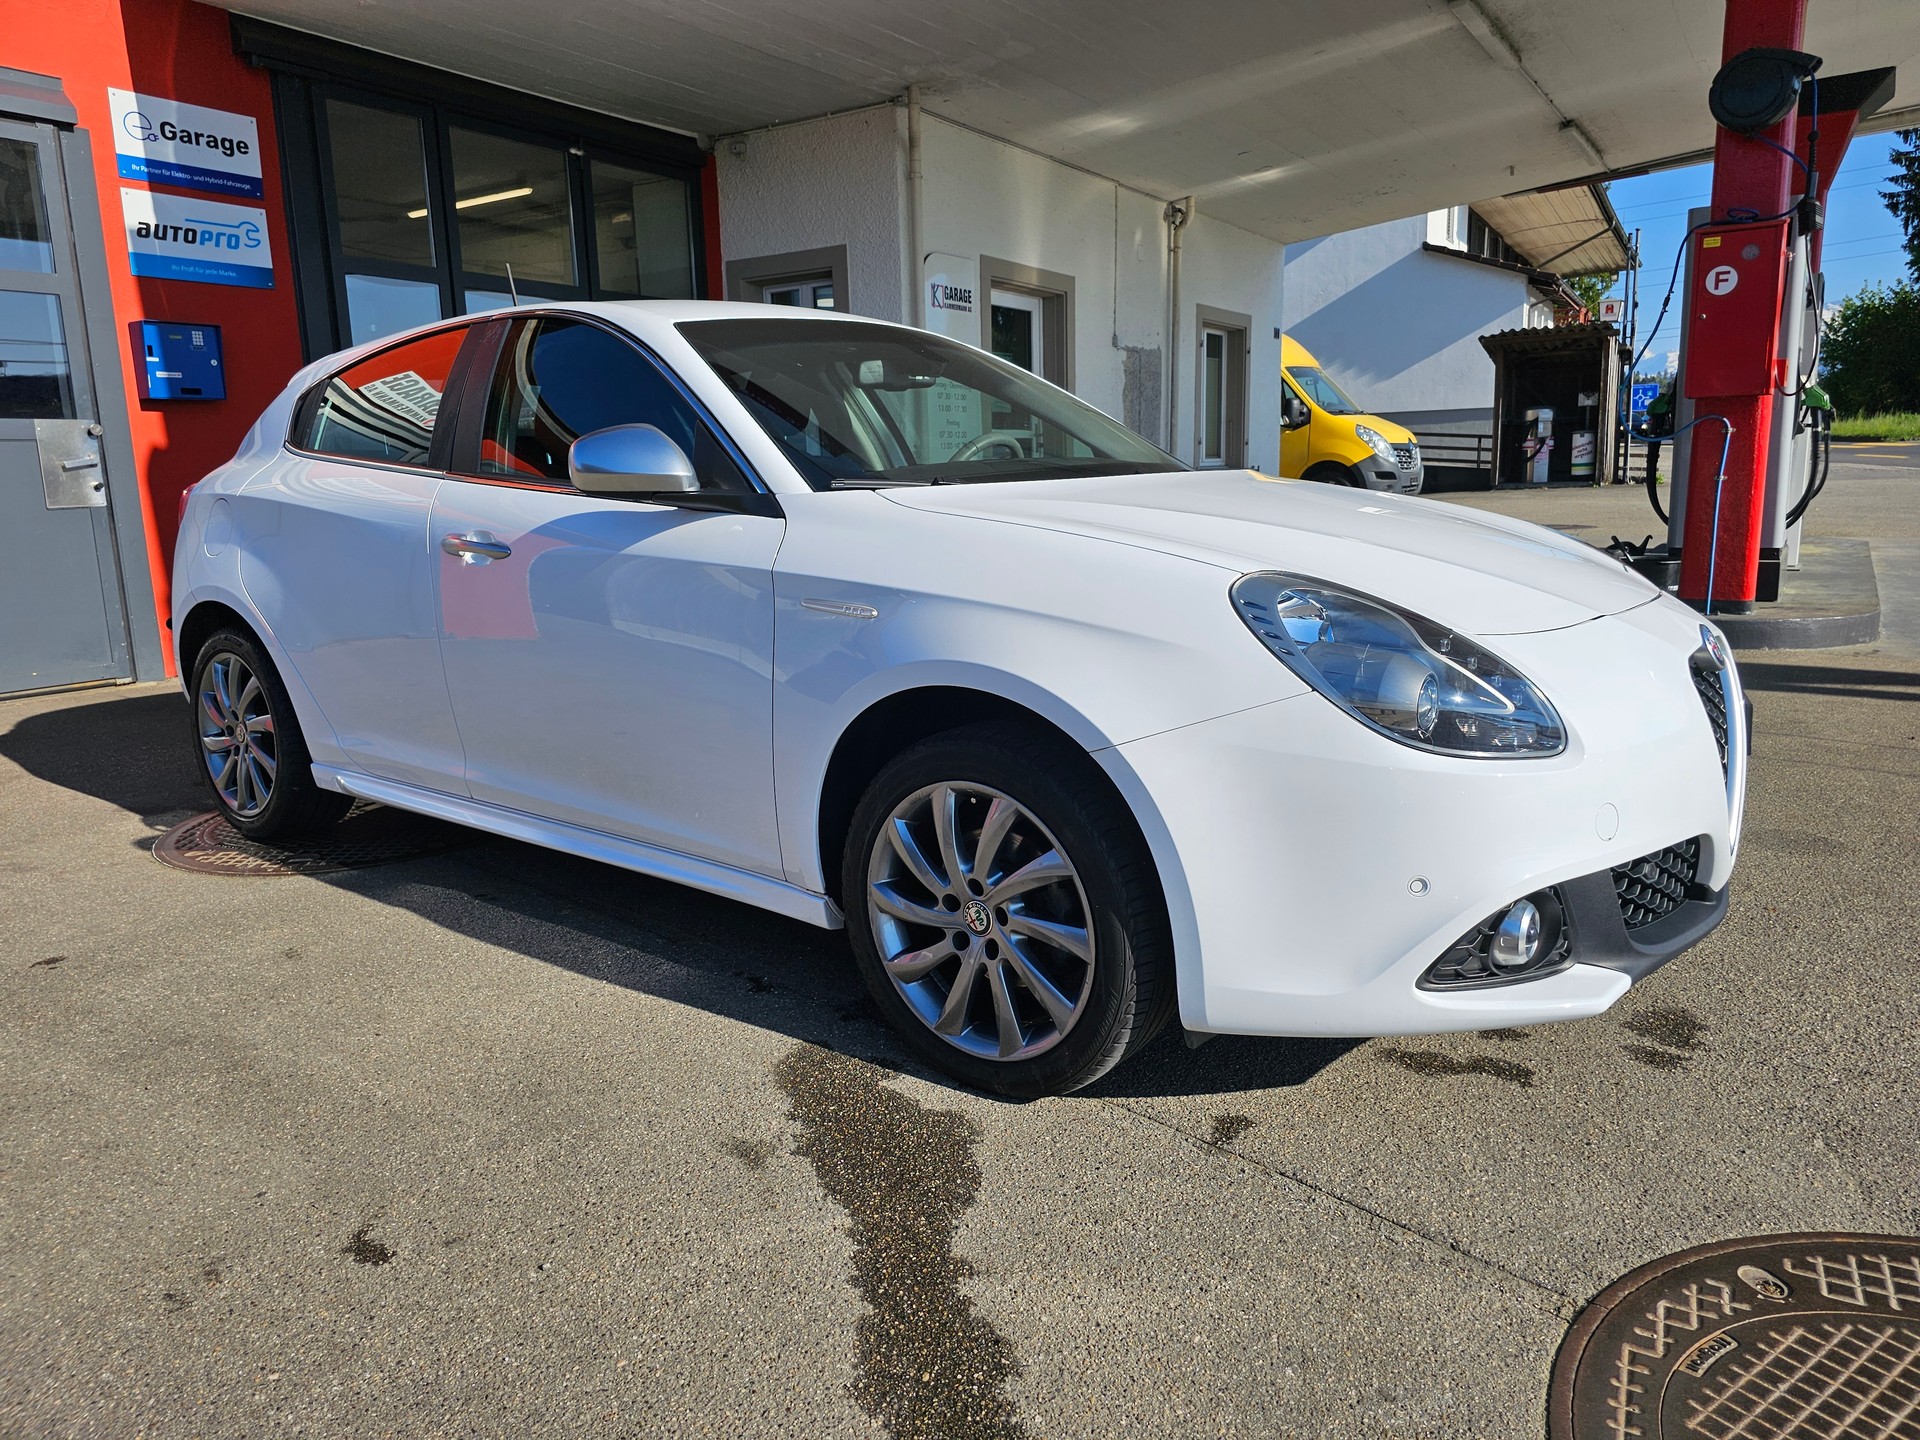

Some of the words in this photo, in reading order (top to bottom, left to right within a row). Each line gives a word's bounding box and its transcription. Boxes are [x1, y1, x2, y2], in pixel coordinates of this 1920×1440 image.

[159, 121, 250, 158] Garage
[131, 164, 140, 172] Ihr
[140, 165, 162, 175] Partner
[162, 167, 171, 176] für
[171, 170, 192, 179] Elektro-
[193, 174, 204, 182] und
[181, 265, 195, 273] Profi
[195, 266, 205, 274] für
[205, 268, 218, 276] jede
[1713, 270, 1731, 291] F
[944, 285, 972, 304] GARAGE
